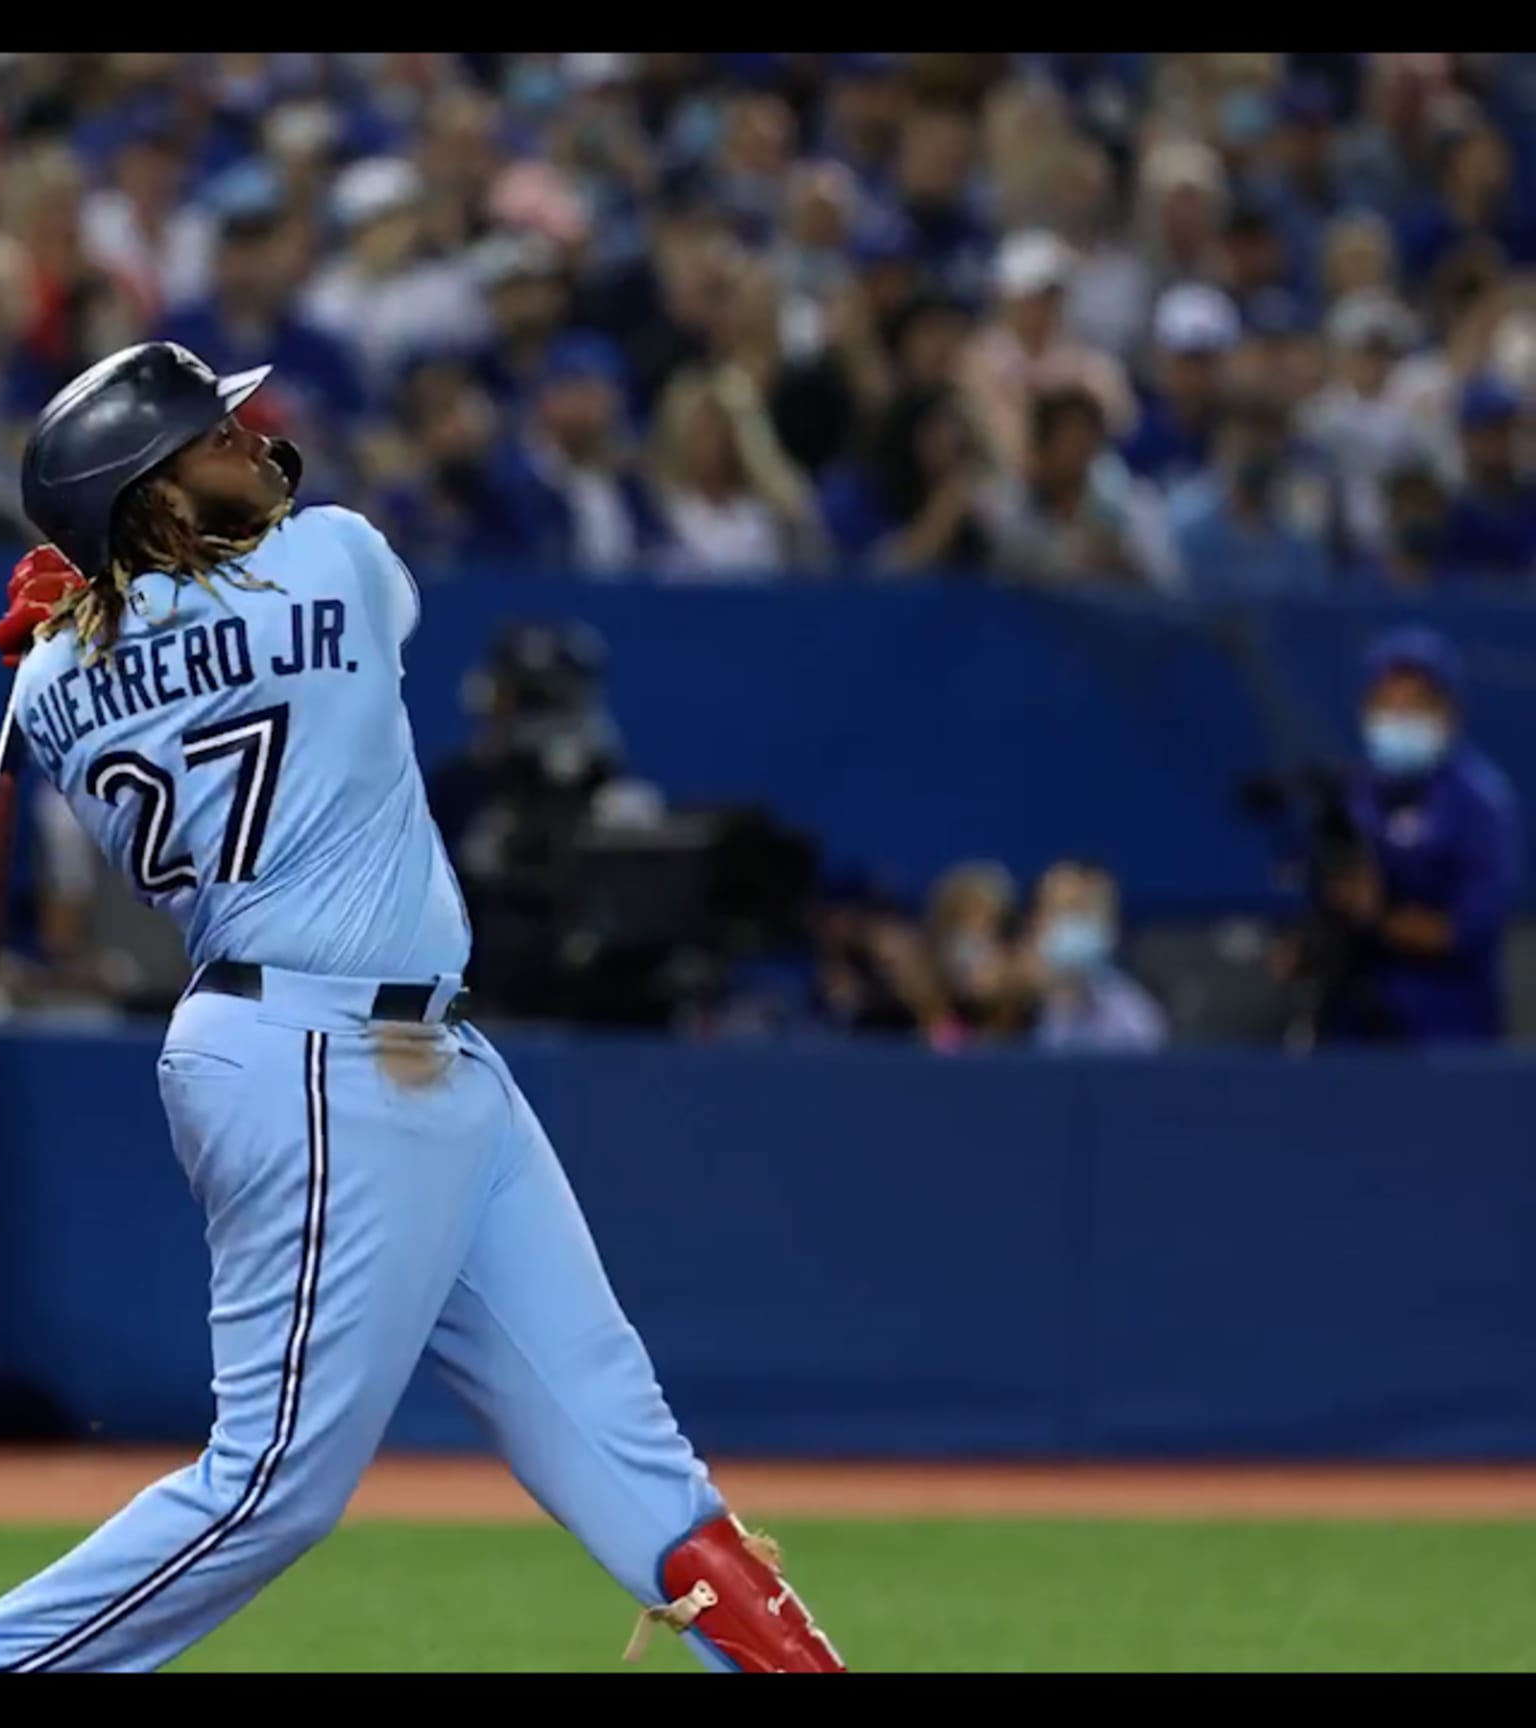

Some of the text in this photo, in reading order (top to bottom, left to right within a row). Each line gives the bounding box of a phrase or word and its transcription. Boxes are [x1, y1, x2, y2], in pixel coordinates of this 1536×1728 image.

[26, 598, 358, 771] GUERRERO JR.
[85, 702, 290, 892] 27
